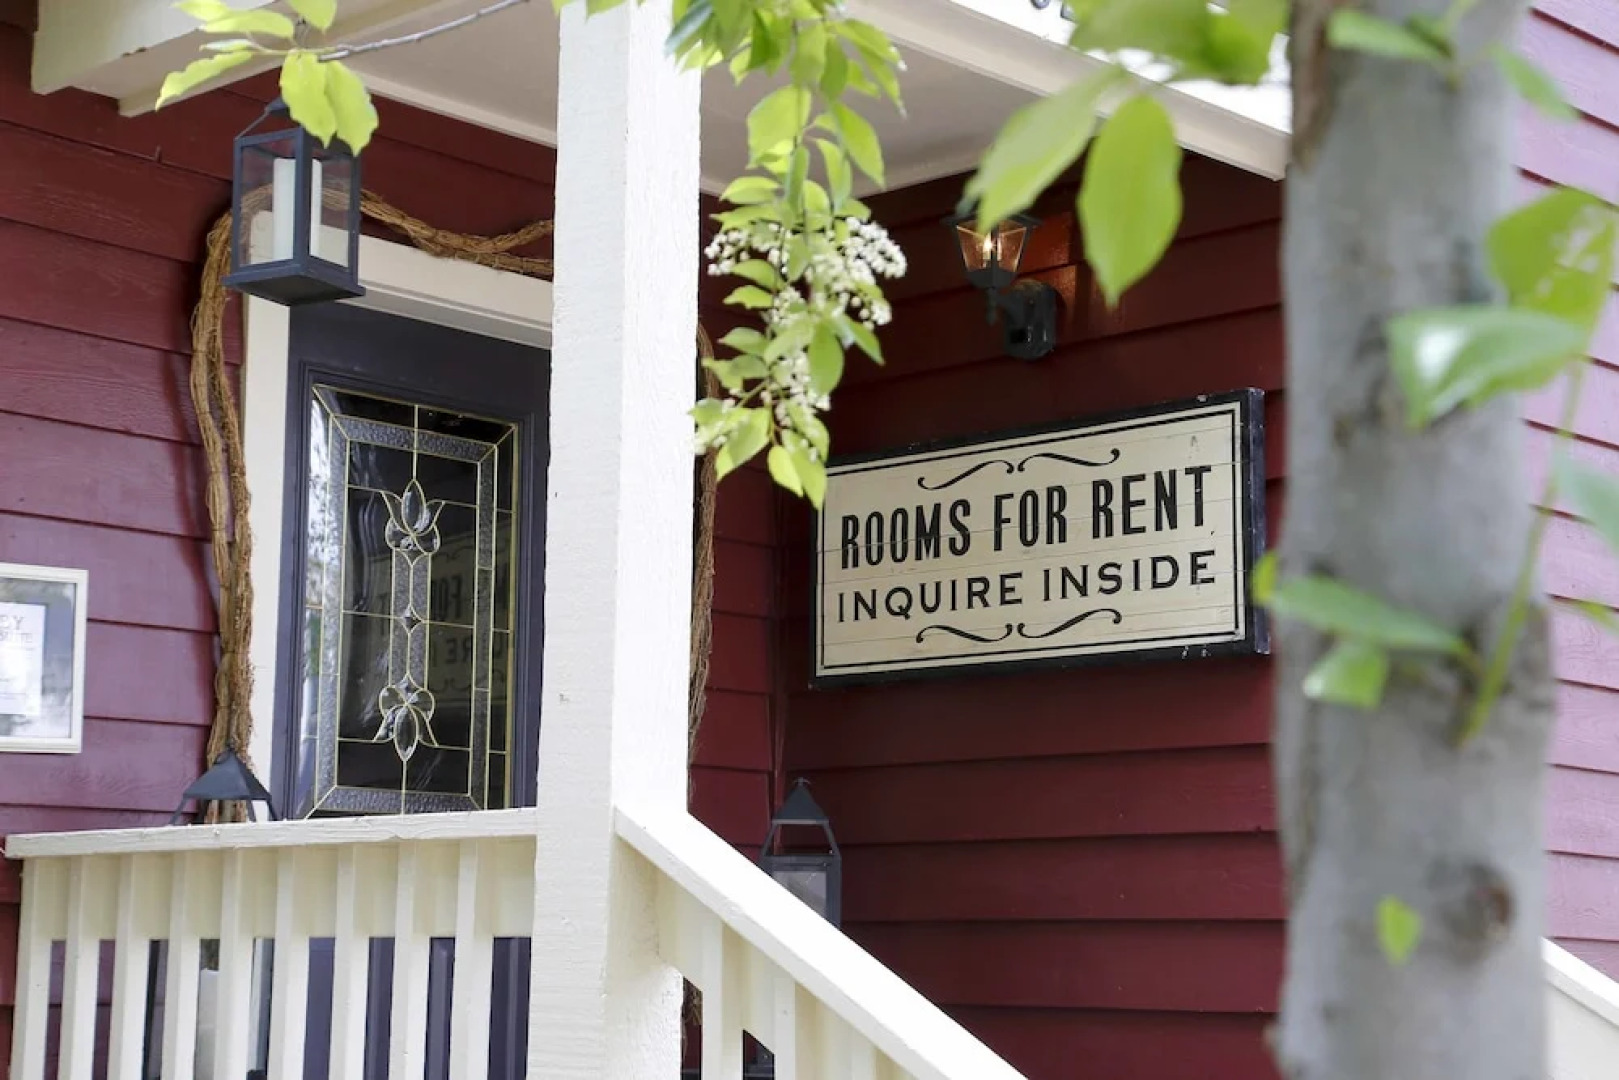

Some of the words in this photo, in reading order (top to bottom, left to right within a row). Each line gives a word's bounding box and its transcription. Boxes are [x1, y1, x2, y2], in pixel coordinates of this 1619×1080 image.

[841, 499, 971, 569] ROOMS
[993, 485, 1068, 551] FOR
[1092, 465, 1212, 539] RENT
[837, 571, 1023, 622] INQUIRE
[1043, 549, 1216, 602] INSIDE
